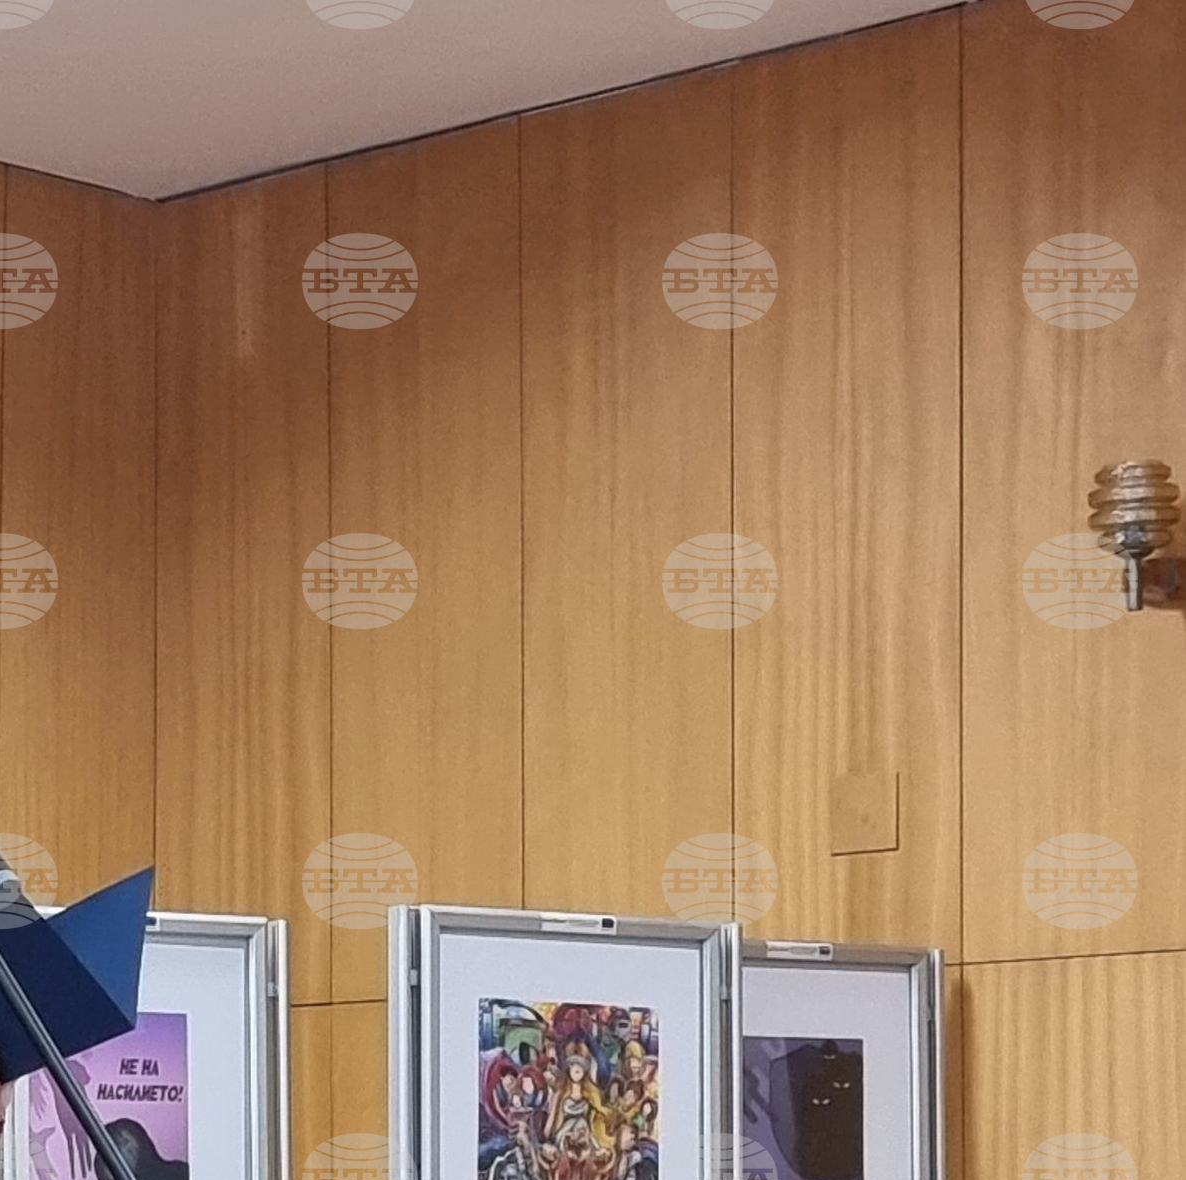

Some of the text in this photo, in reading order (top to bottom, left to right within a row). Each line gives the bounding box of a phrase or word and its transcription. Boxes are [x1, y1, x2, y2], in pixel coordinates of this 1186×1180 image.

[119, 1058, 159, 1076] НЕ НА
[97, 1083, 184, 1102] НАСИЛИЕТО!
